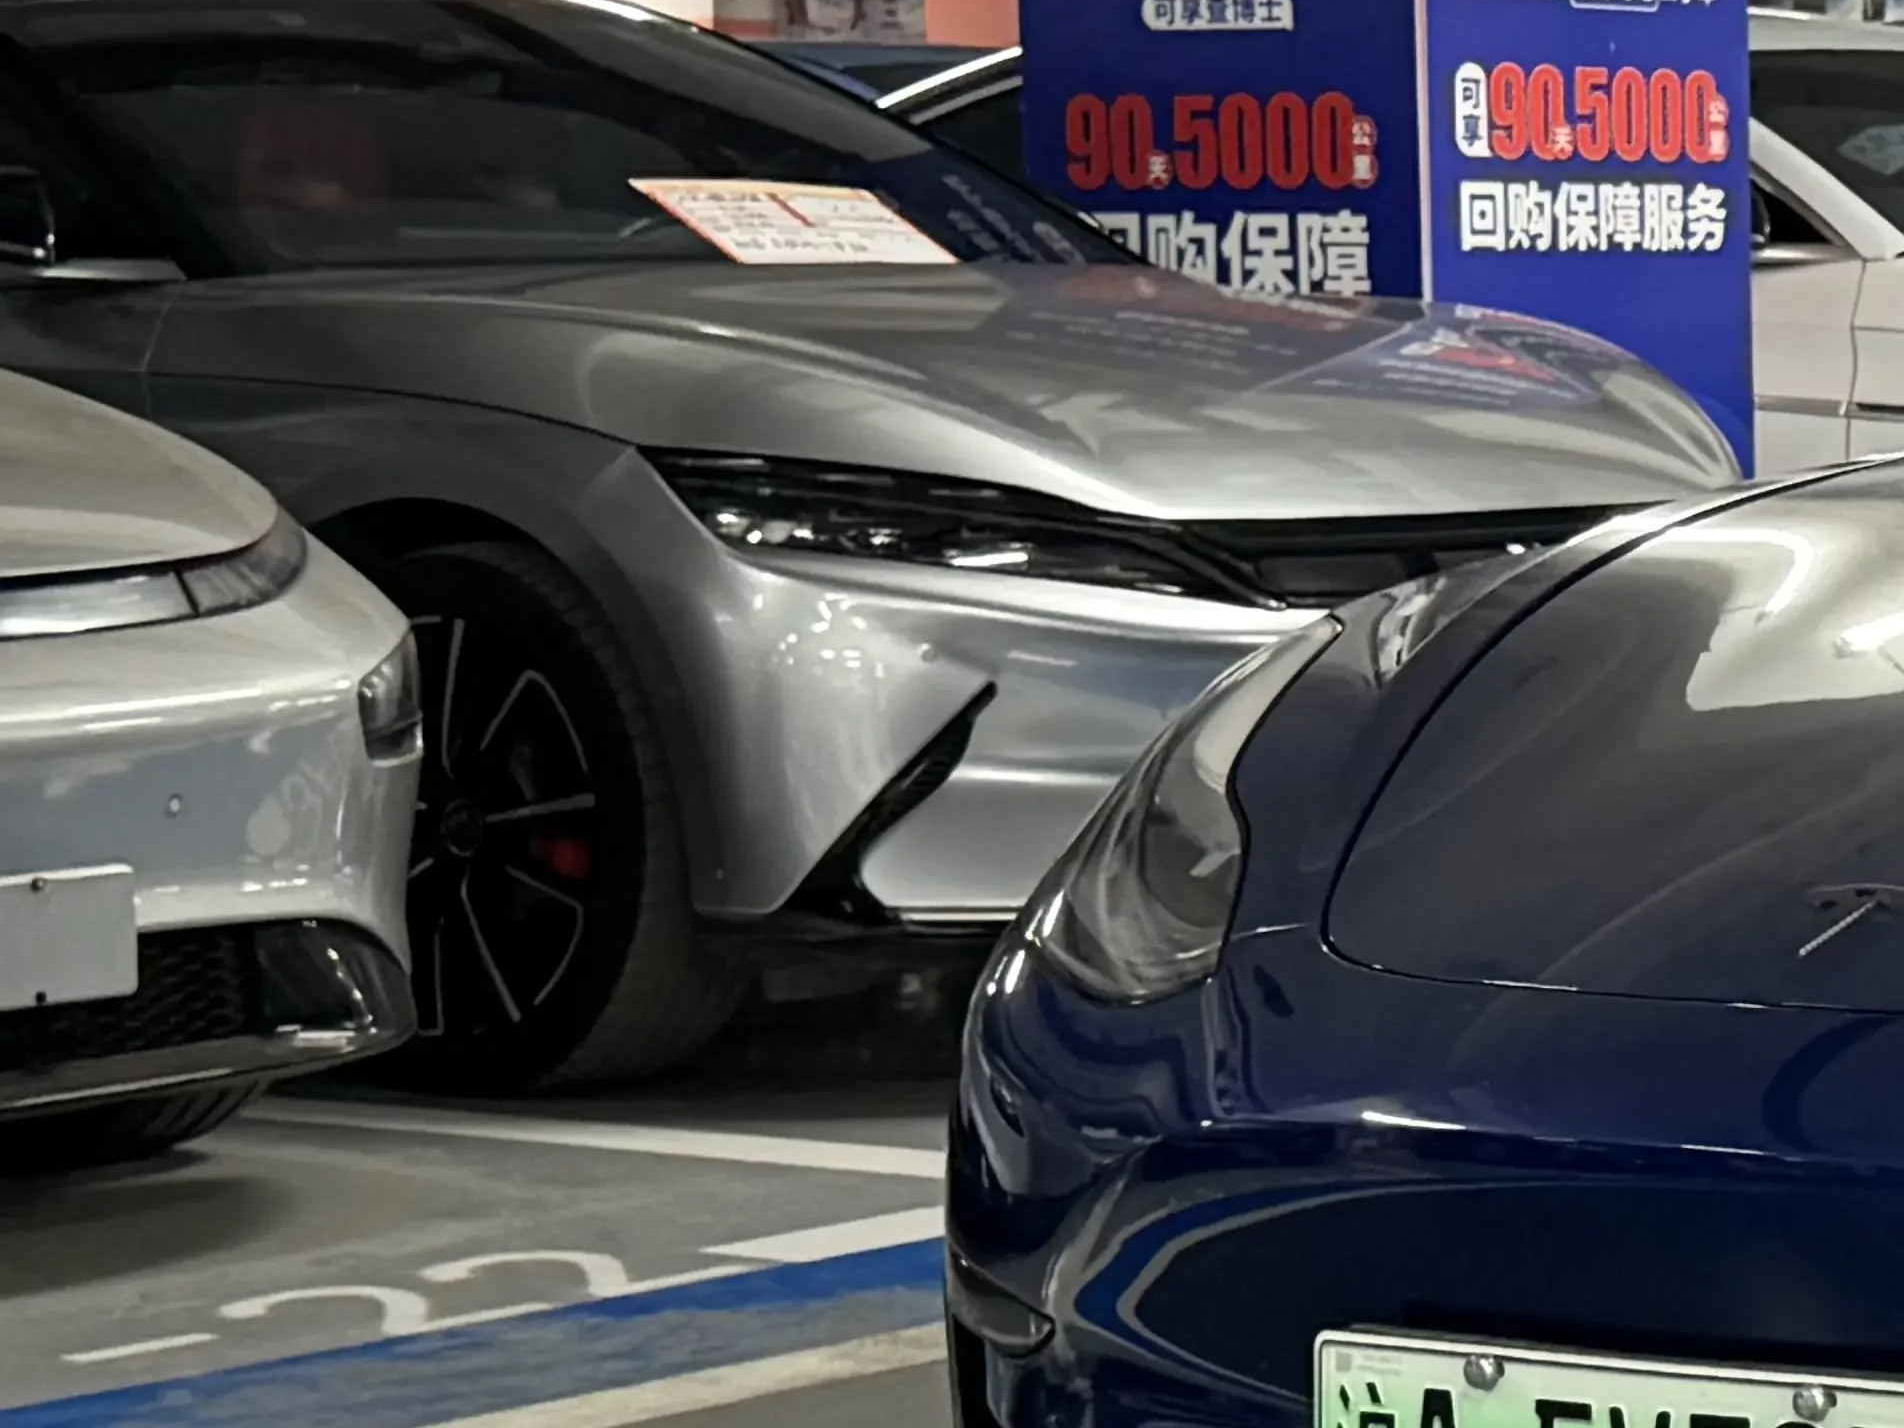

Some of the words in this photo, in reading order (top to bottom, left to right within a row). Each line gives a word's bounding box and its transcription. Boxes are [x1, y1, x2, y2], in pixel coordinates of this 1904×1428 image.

[1461, 76, 1482, 147] 可享
[1460, 179, 1727, 252] 回购保障服务
